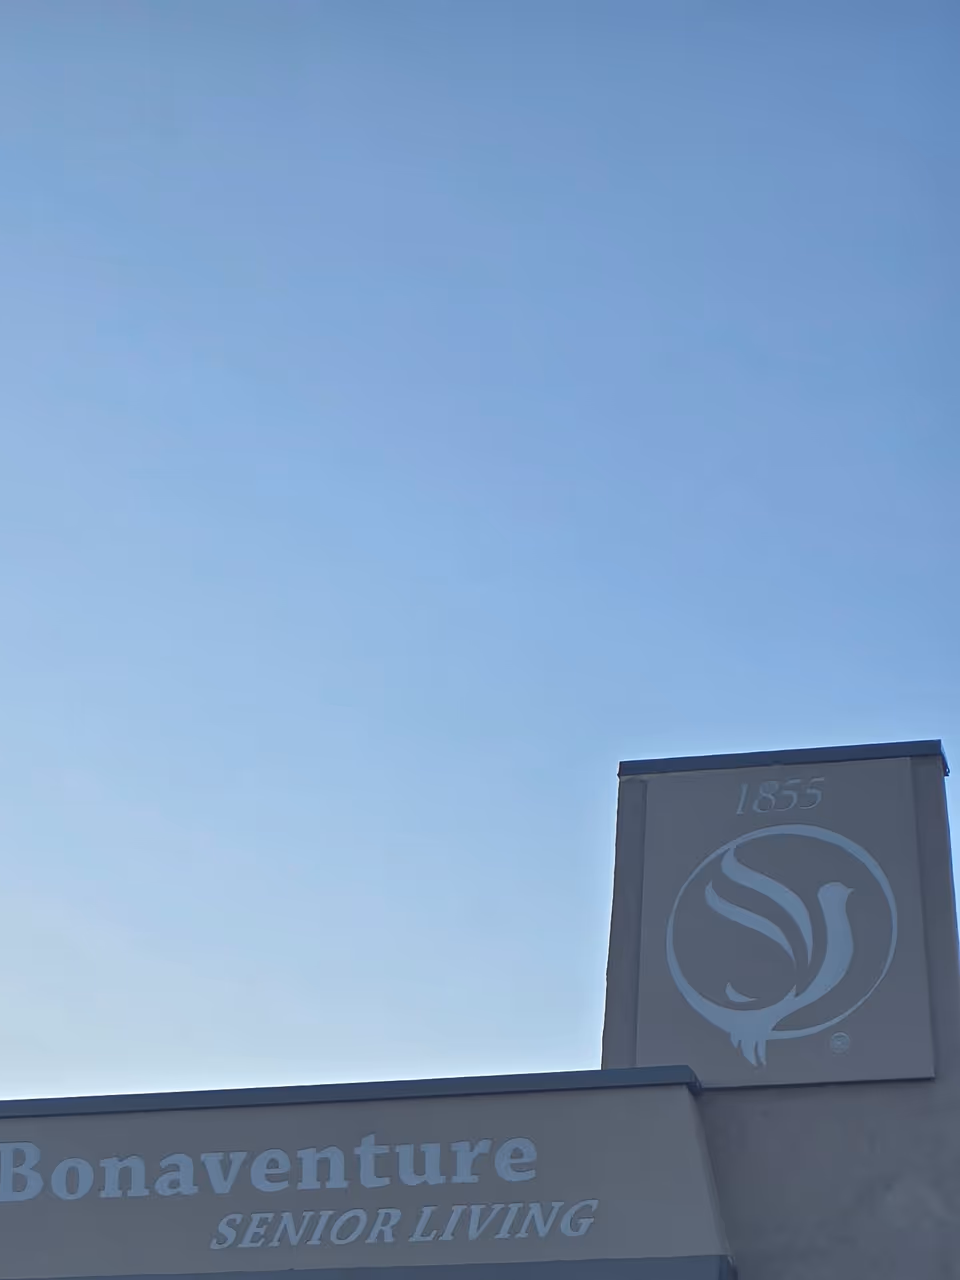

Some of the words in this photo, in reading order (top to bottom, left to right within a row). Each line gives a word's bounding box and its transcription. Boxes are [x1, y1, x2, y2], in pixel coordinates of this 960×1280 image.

[735, 776, 825, 815] 1855
[209, 1206, 402, 1250] SENIOR
[407, 1198, 599, 1243] LIVING
